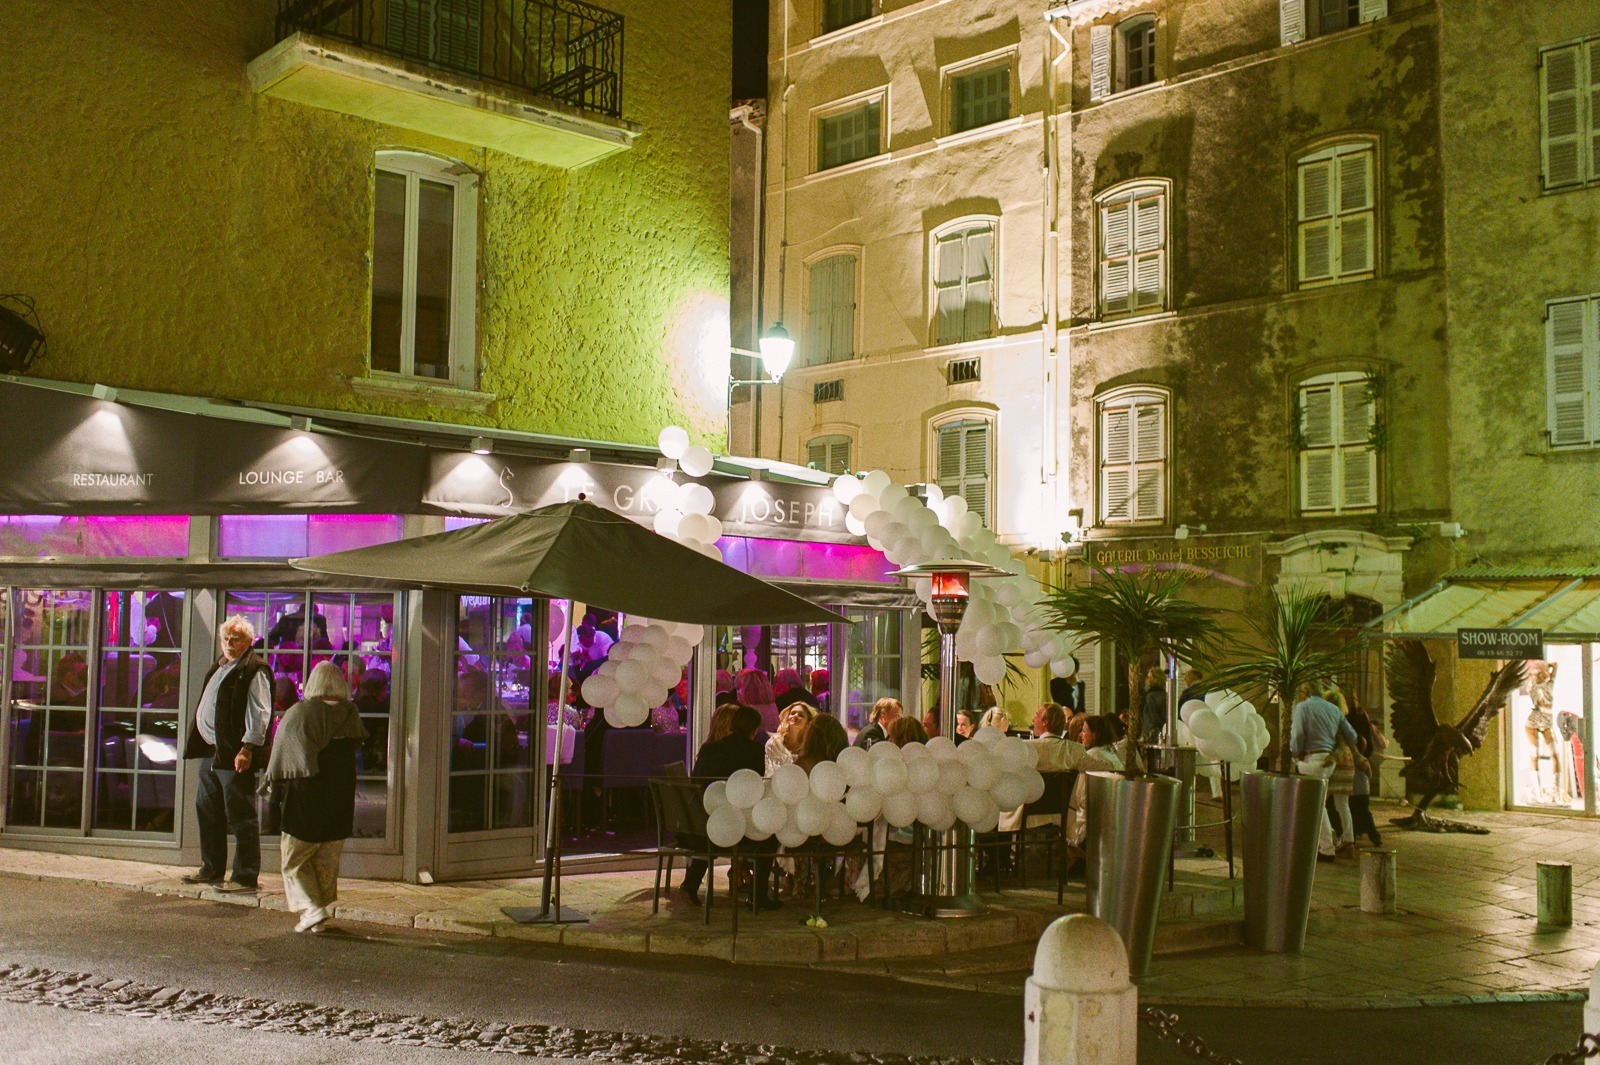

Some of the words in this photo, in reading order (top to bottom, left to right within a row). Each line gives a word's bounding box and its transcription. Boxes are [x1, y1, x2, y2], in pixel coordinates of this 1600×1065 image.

[73, 473, 154, 487] RESTAURANT
[239, 470, 304, 485] LOUNGE
[316, 469, 345, 484] BAR
[735, 496, 834, 527] JOSEPH
[1461, 631, 1539, 646] SHOW-ROOM
